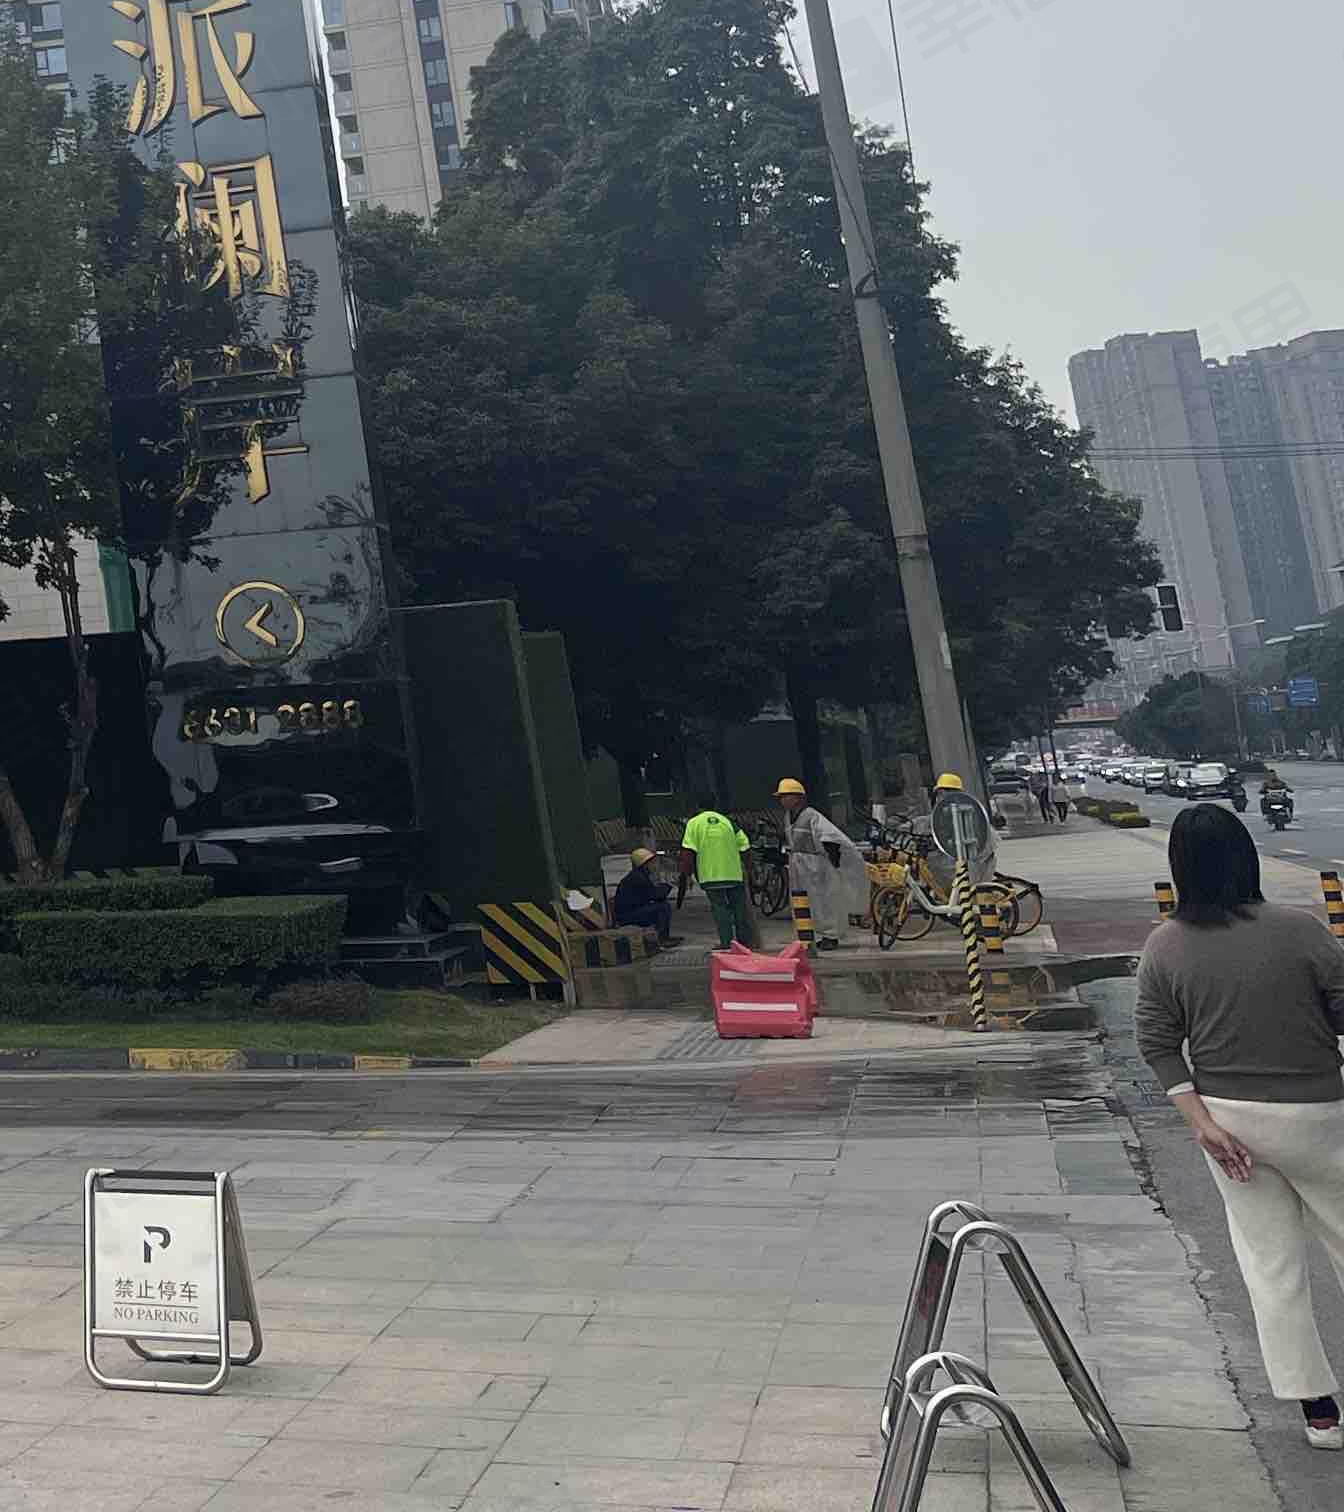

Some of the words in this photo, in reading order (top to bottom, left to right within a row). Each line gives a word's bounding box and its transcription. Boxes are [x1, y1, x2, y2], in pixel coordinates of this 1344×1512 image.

[143, 1225, 172, 1264] P
[114, 1278, 199, 1303] 禁止停车
[113, 1306, 134, 1321] NO
[136, 1307, 200, 1325] PARKING
